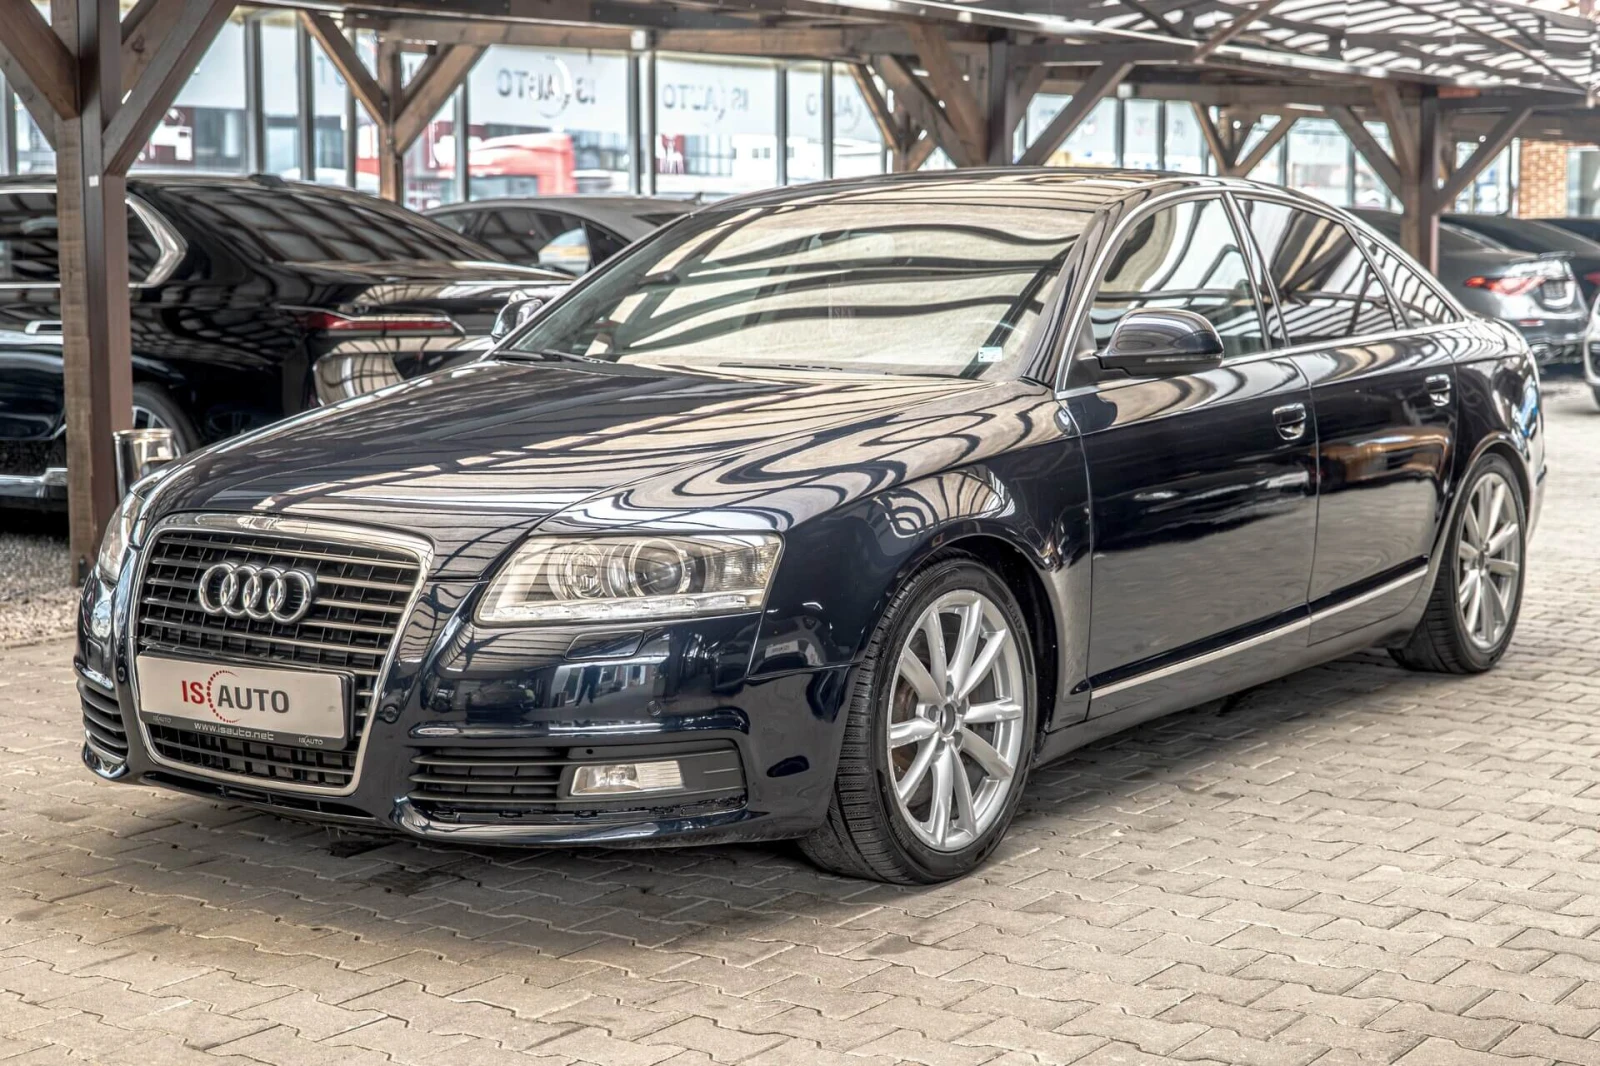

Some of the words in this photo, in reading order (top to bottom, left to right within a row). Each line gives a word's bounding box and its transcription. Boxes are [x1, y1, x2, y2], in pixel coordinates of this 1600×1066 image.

[181, 680, 205, 704] IS
[217, 685, 290, 713] AUTO
[194, 722, 275, 741] www.isauto.net
[305, 737, 323, 745] AUTO
